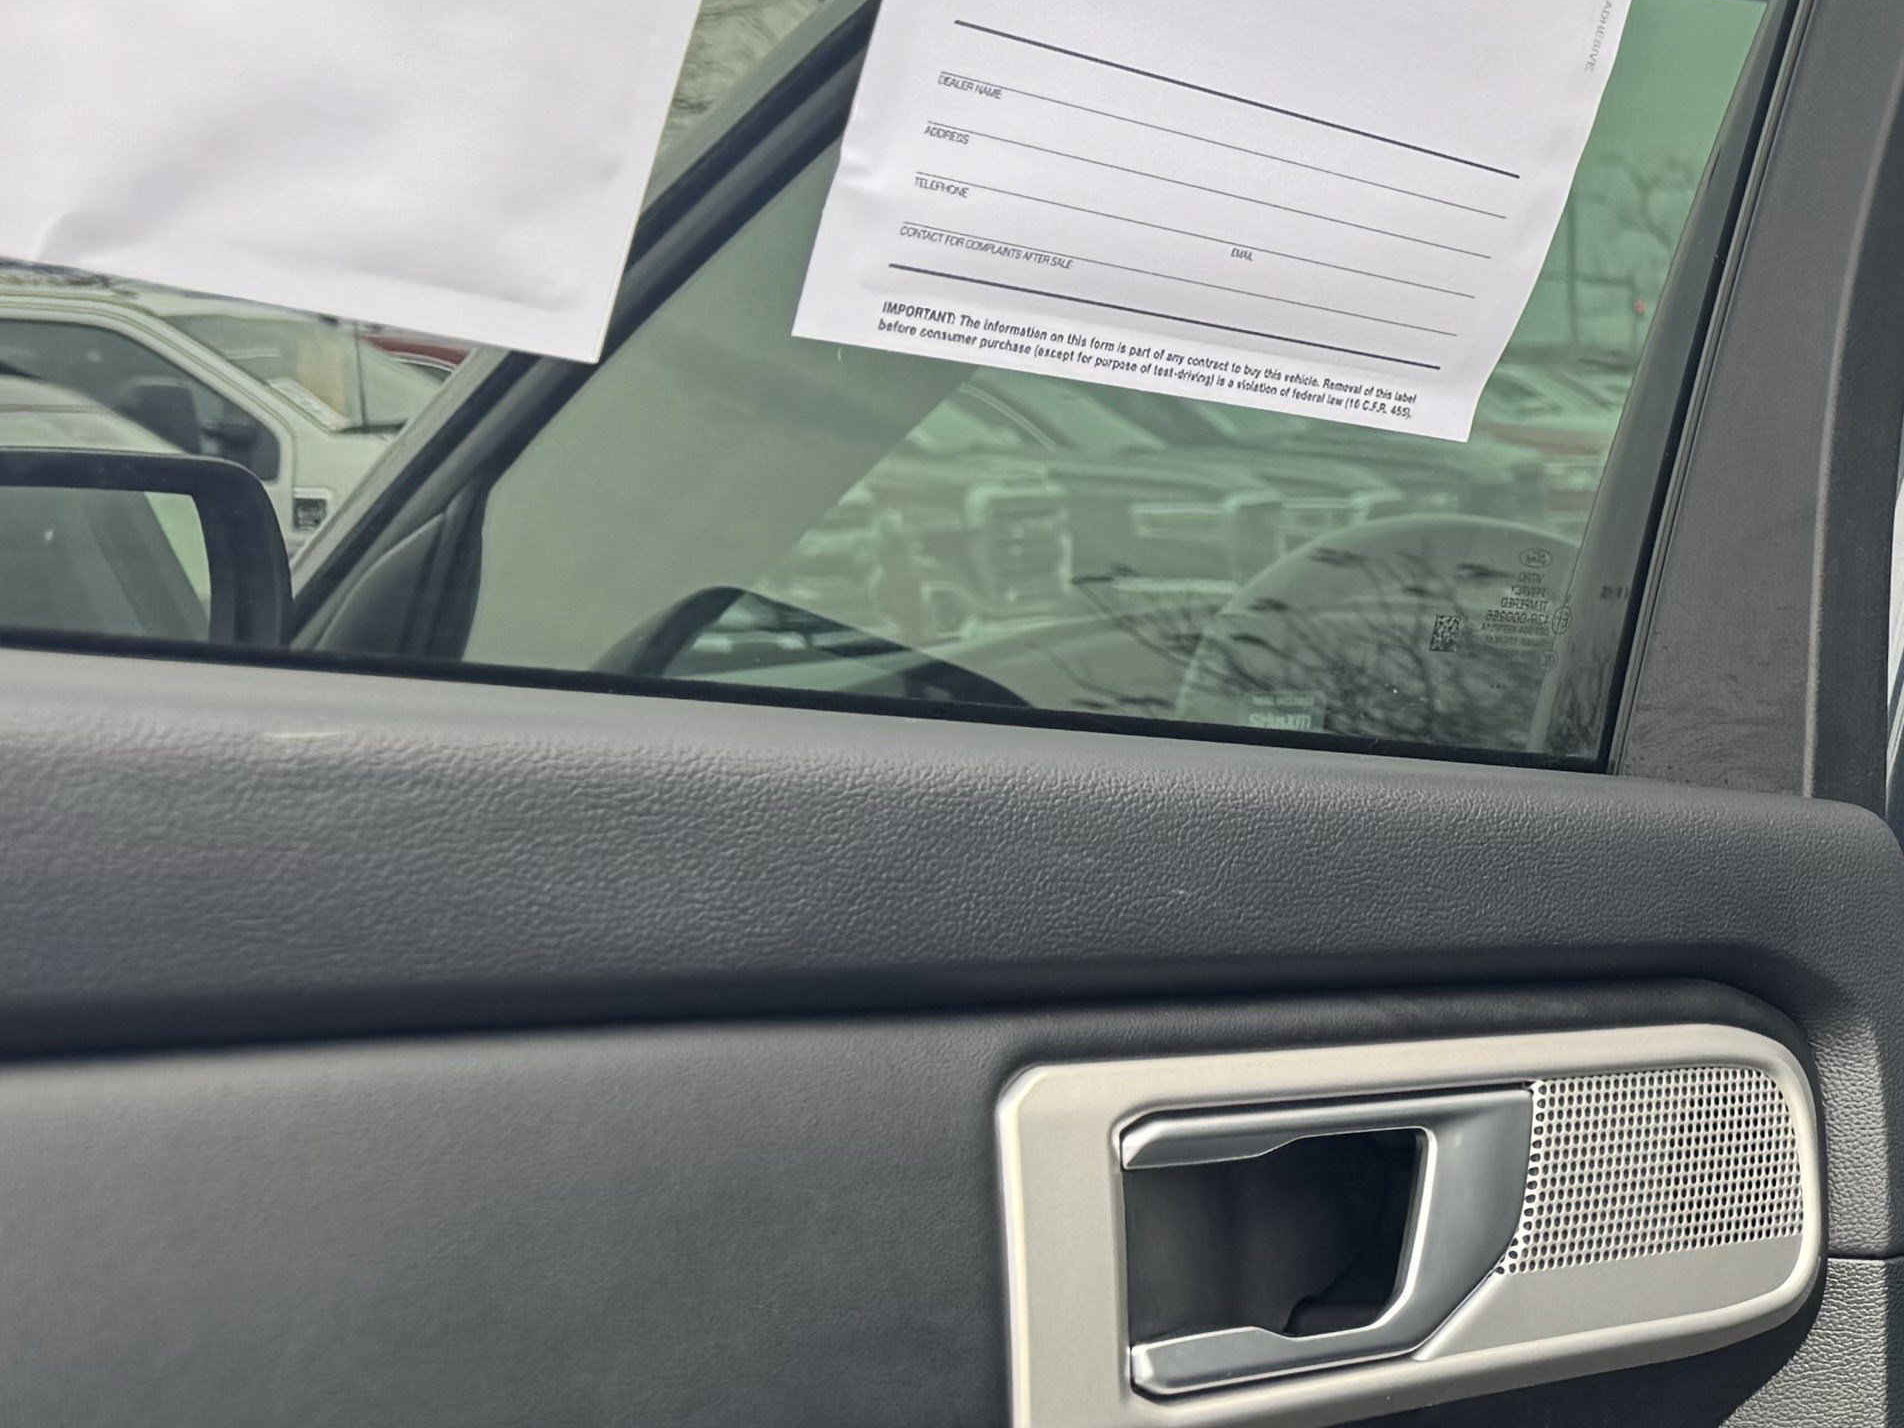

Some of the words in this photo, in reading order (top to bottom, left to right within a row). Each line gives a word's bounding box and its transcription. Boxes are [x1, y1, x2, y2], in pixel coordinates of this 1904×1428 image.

[1585, 0, 1612, 71] ADHESIVE
[878, 317, 916, 335] before
[920, 327, 977, 345] consumer
[979, 337, 1031, 354] purchase
[1034, 344, 1074, 362] (except
[1077, 351, 1092, 363] for
[1094, 356, 1137, 371] purpose
[1140, 363, 1152, 373] of
[1154, 364, 1214, 386] test-driving)
[1216, 375, 1225, 386] is
[1228, 379, 1234, 388] a
[1237, 379, 1277, 394] violation
[1280, 387, 1290, 397] of
[1292, 388, 1325, 402] federal
[1327, 394, 1343, 406] law
[882, 301, 955, 324] IMPORTANT:
[961, 314, 980, 329] The
[984, 318, 1047, 340] information
[1050, 333, 1064, 342] on
[1067, 333, 1086, 347] this
[1090, 336, 1114, 351] form
[1117, 341, 1126, 353] is
[1129, 346, 1151, 358] part
[1153, 348, 1165, 359] of
[1166, 352, 1185, 365] any
[1187, 356, 1229, 371] contract
[1231, 362, 1241, 373] to
[1244, 364, 1261, 379] buy
[1264, 368, 1281, 380] this
[1285, 373, 1319, 386] vehicle.
[1323, 377, 1362, 394] Removal
[1364, 386, 1374, 396] of
[1376, 388, 1392, 400] this
[1395, 391, 1417, 403] label
